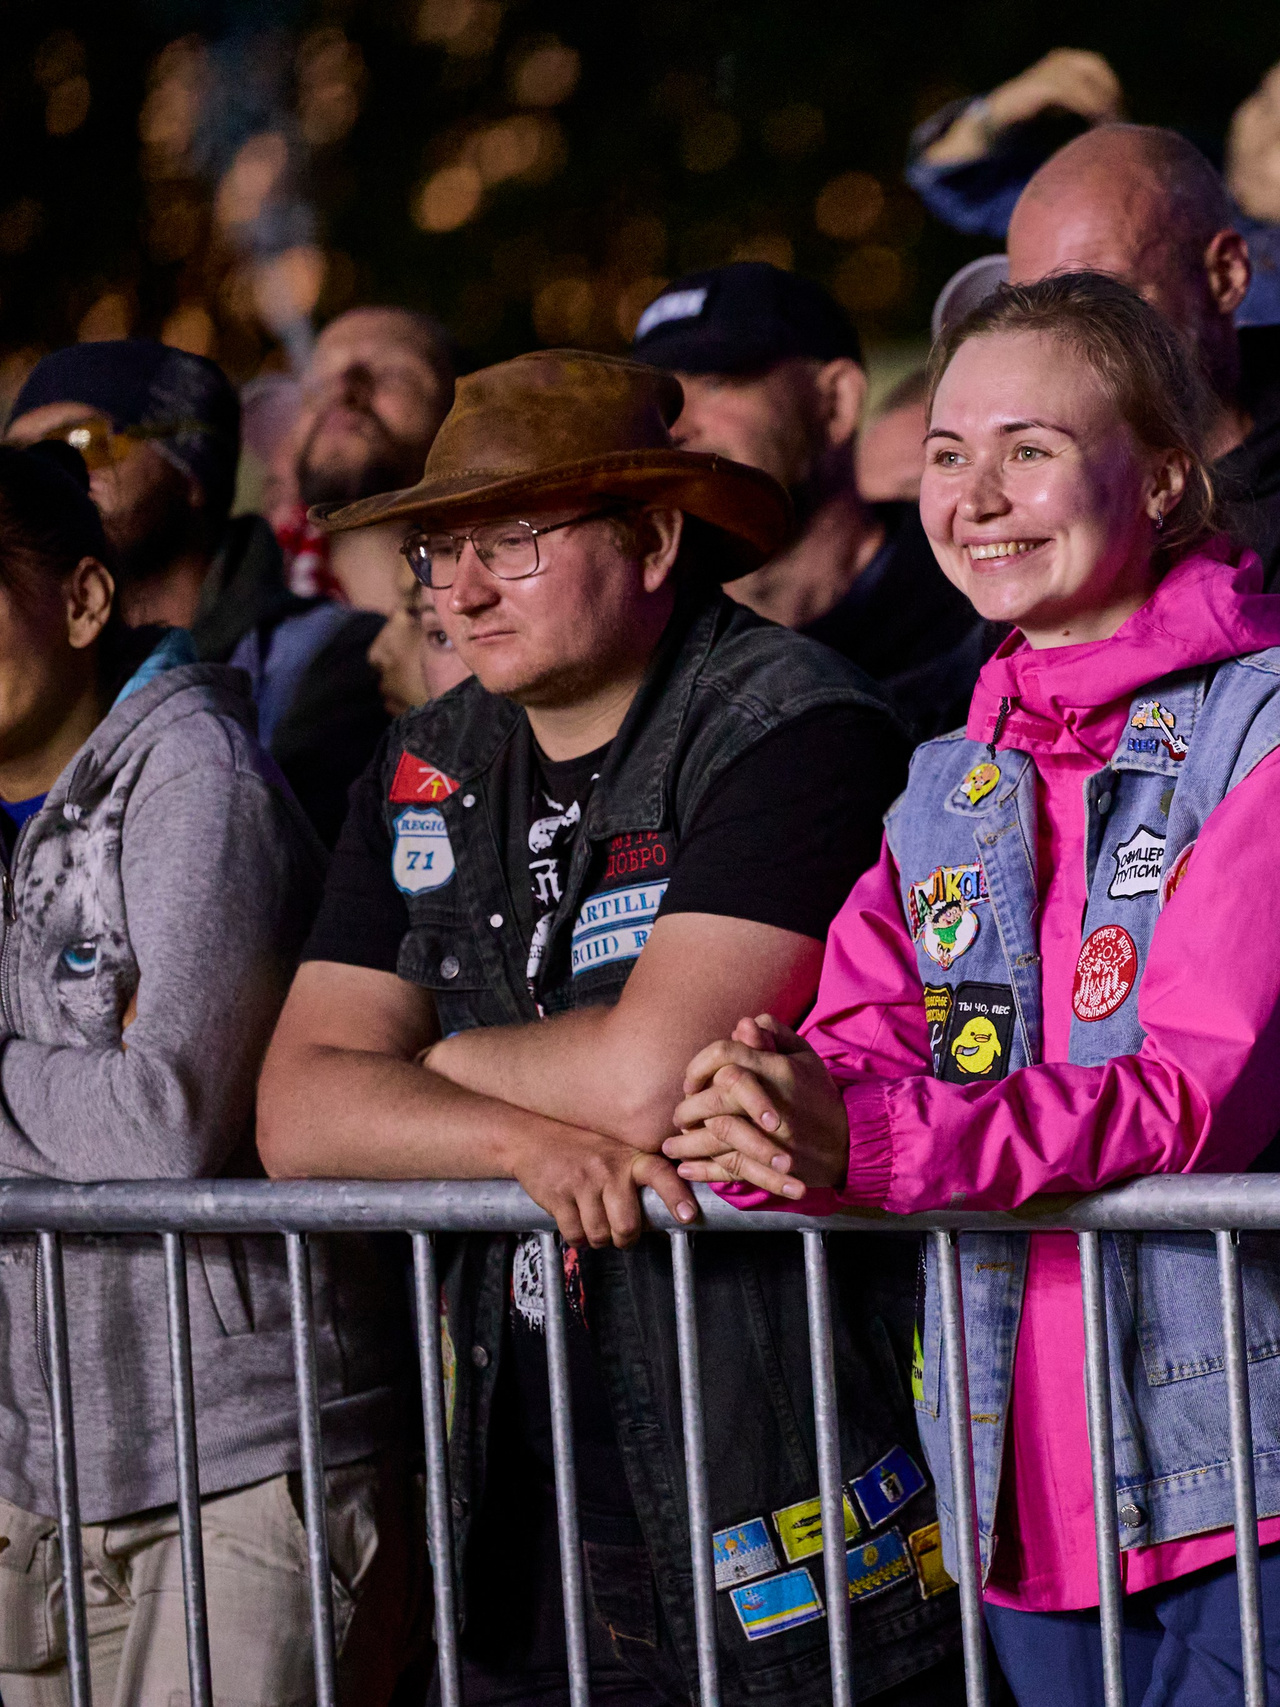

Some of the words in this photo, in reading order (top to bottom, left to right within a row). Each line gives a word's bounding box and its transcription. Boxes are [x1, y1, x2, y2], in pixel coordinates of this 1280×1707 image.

[406, 850, 435, 870] 71
[604, 843, 667, 880] ДОБРО
[1120, 847, 1165, 868] ОФИЦЕР
[1116, 864, 1161, 885] ПУПСИК
[958, 1001, 972, 1012] ТЫ
[974, 1003, 989, 1014] ЧО,
[991, 1004, 1011, 1015] ПЕС
